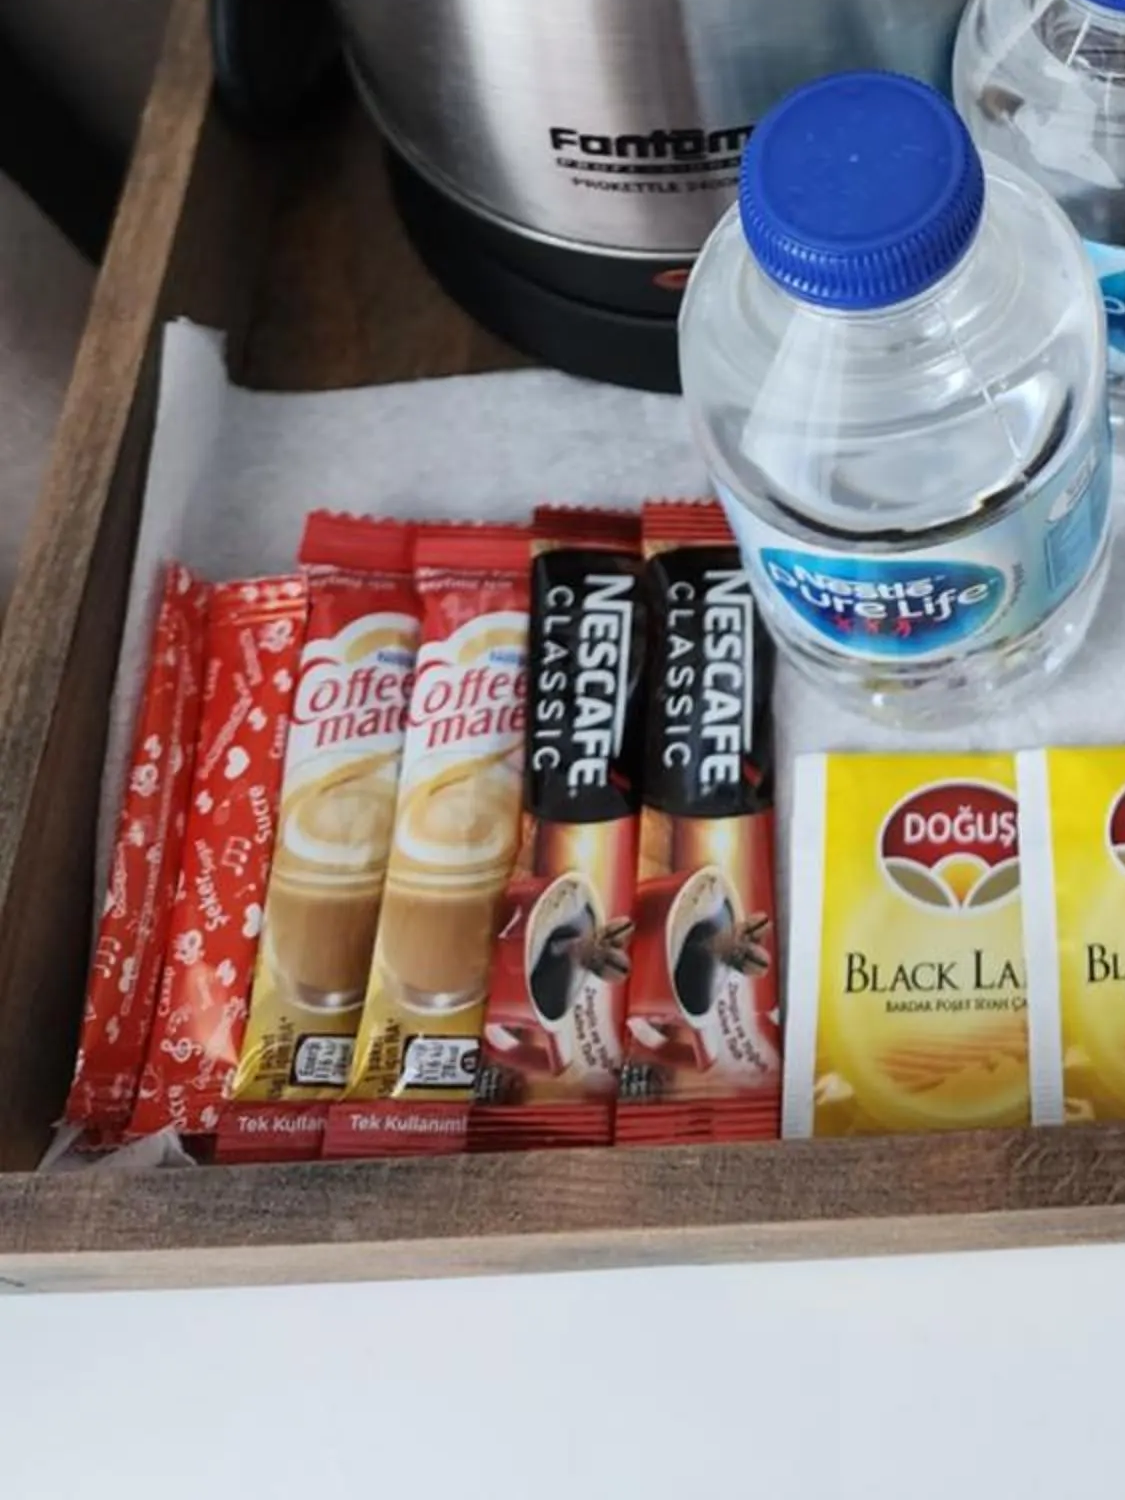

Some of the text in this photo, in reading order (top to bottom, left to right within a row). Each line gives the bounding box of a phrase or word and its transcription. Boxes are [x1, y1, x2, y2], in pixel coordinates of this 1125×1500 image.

[900, 581, 989, 621] Life
[532, 586, 575, 771] CLASSIC
[663, 581, 696, 769] CLASSIC
[250, 784, 272, 845] Sucre
[903, 804, 1016, 848] DOĞUŞ
[844, 949, 1028, 994] BLACK LA
[237, 1115, 268, 1132] Tek
[351, 1113, 380, 1132] Tek
